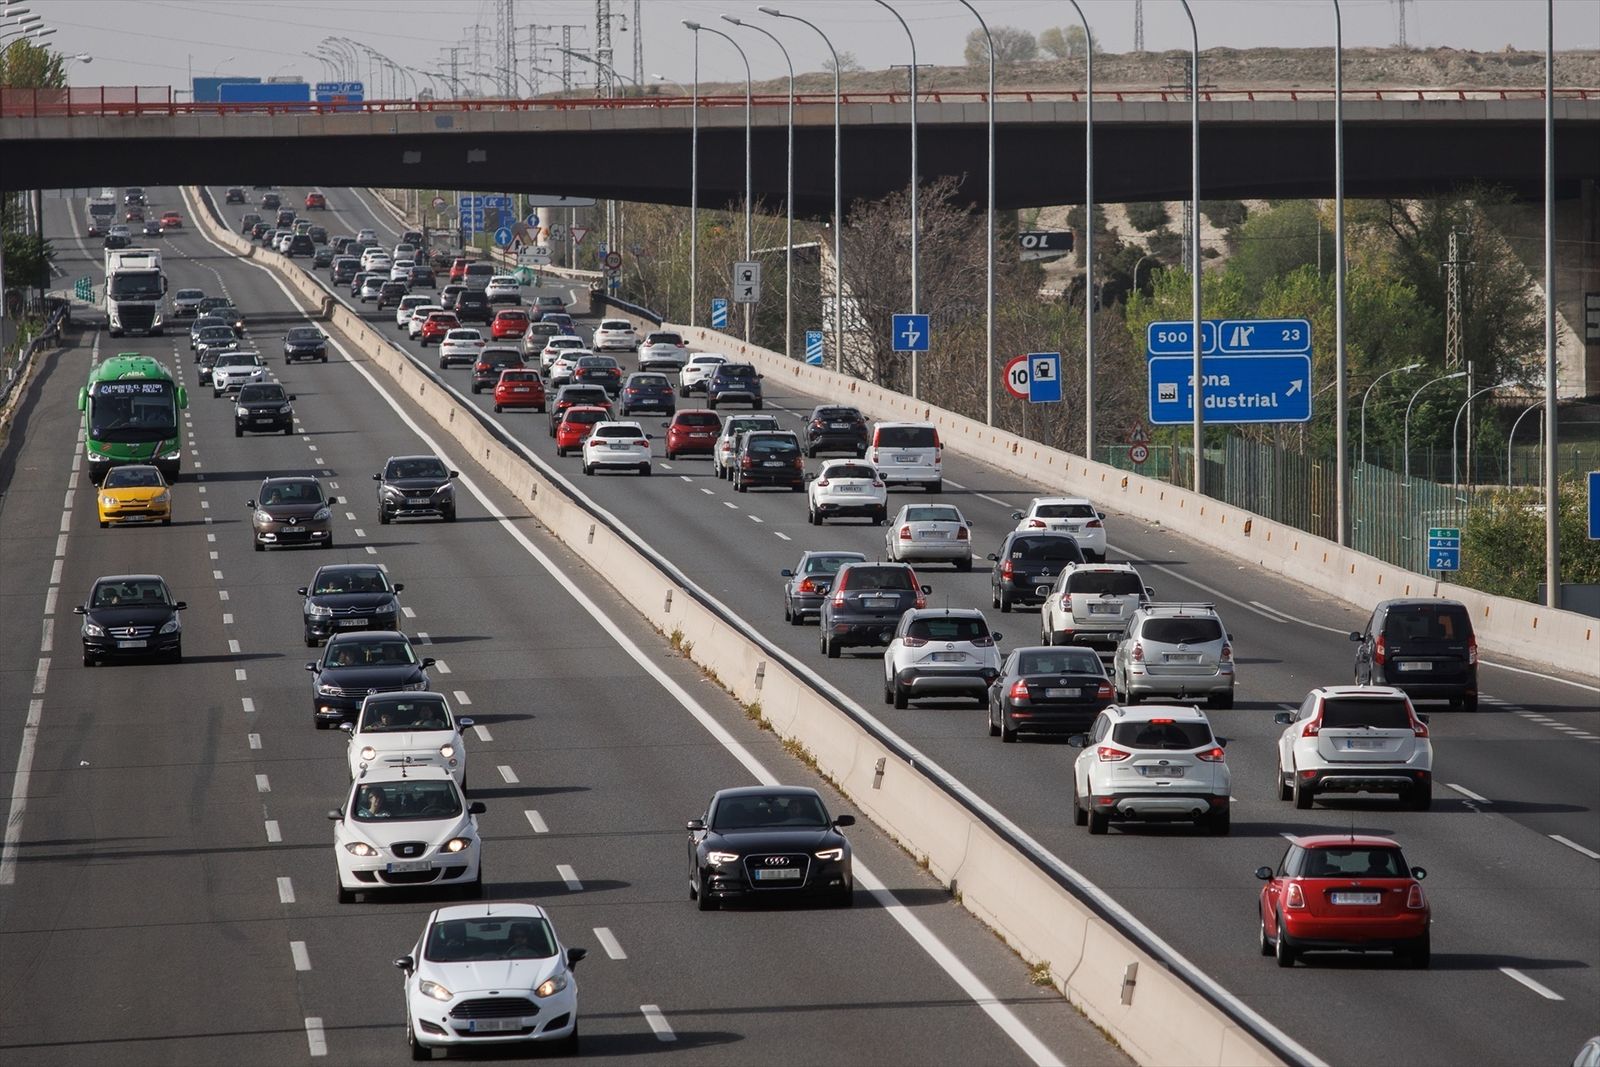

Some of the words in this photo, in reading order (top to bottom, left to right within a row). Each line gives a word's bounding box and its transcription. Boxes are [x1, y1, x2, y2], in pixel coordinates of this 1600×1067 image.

[1019, 235, 1049, 248] OL
[536, 247, 547, 255] 23
[1158, 331, 1187, 343] 500
[1281, 329, 1301, 341] 23
[1011, 369, 1028, 385] 10
[1187, 392, 1278, 408] idustrial
[1134, 450, 1145, 458] 40
[1436, 559, 1451, 567] 24
